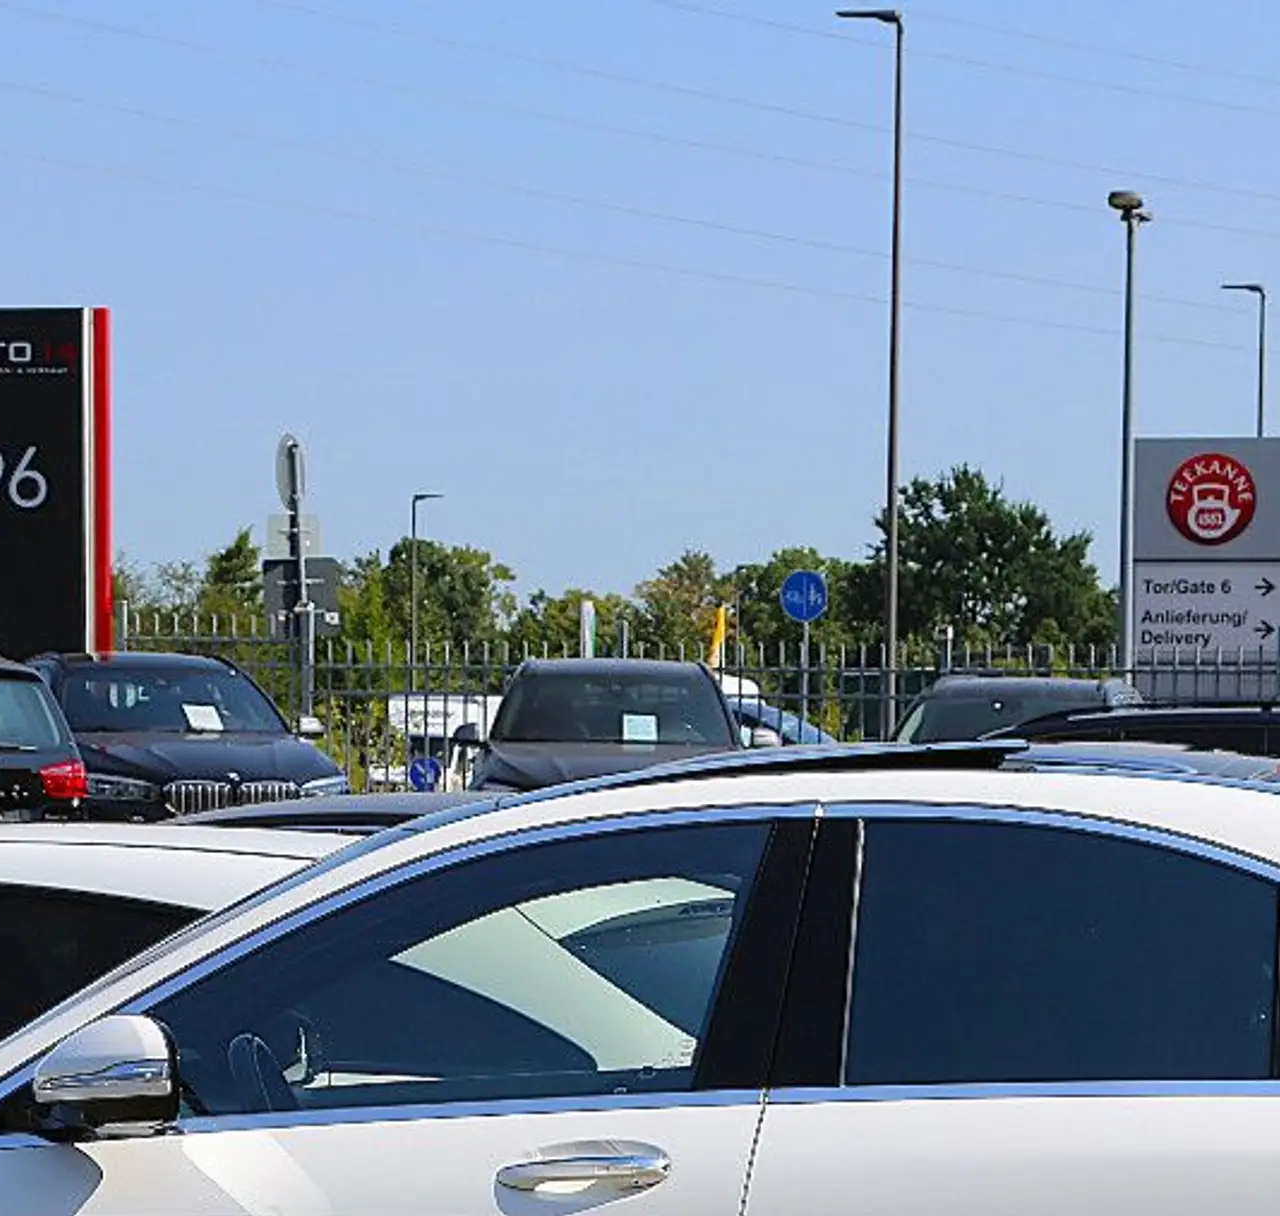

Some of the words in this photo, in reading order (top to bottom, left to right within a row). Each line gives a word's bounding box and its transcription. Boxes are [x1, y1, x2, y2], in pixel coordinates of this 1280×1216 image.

[1170, 460, 1254, 505] TEEKANNE
[1144, 578, 1216, 595] Tor/Gate
[1221, 578, 1233, 595] 6
[1141, 609, 1249, 628] Anlieferung/
[1141, 630, 1212, 649] Delivery
